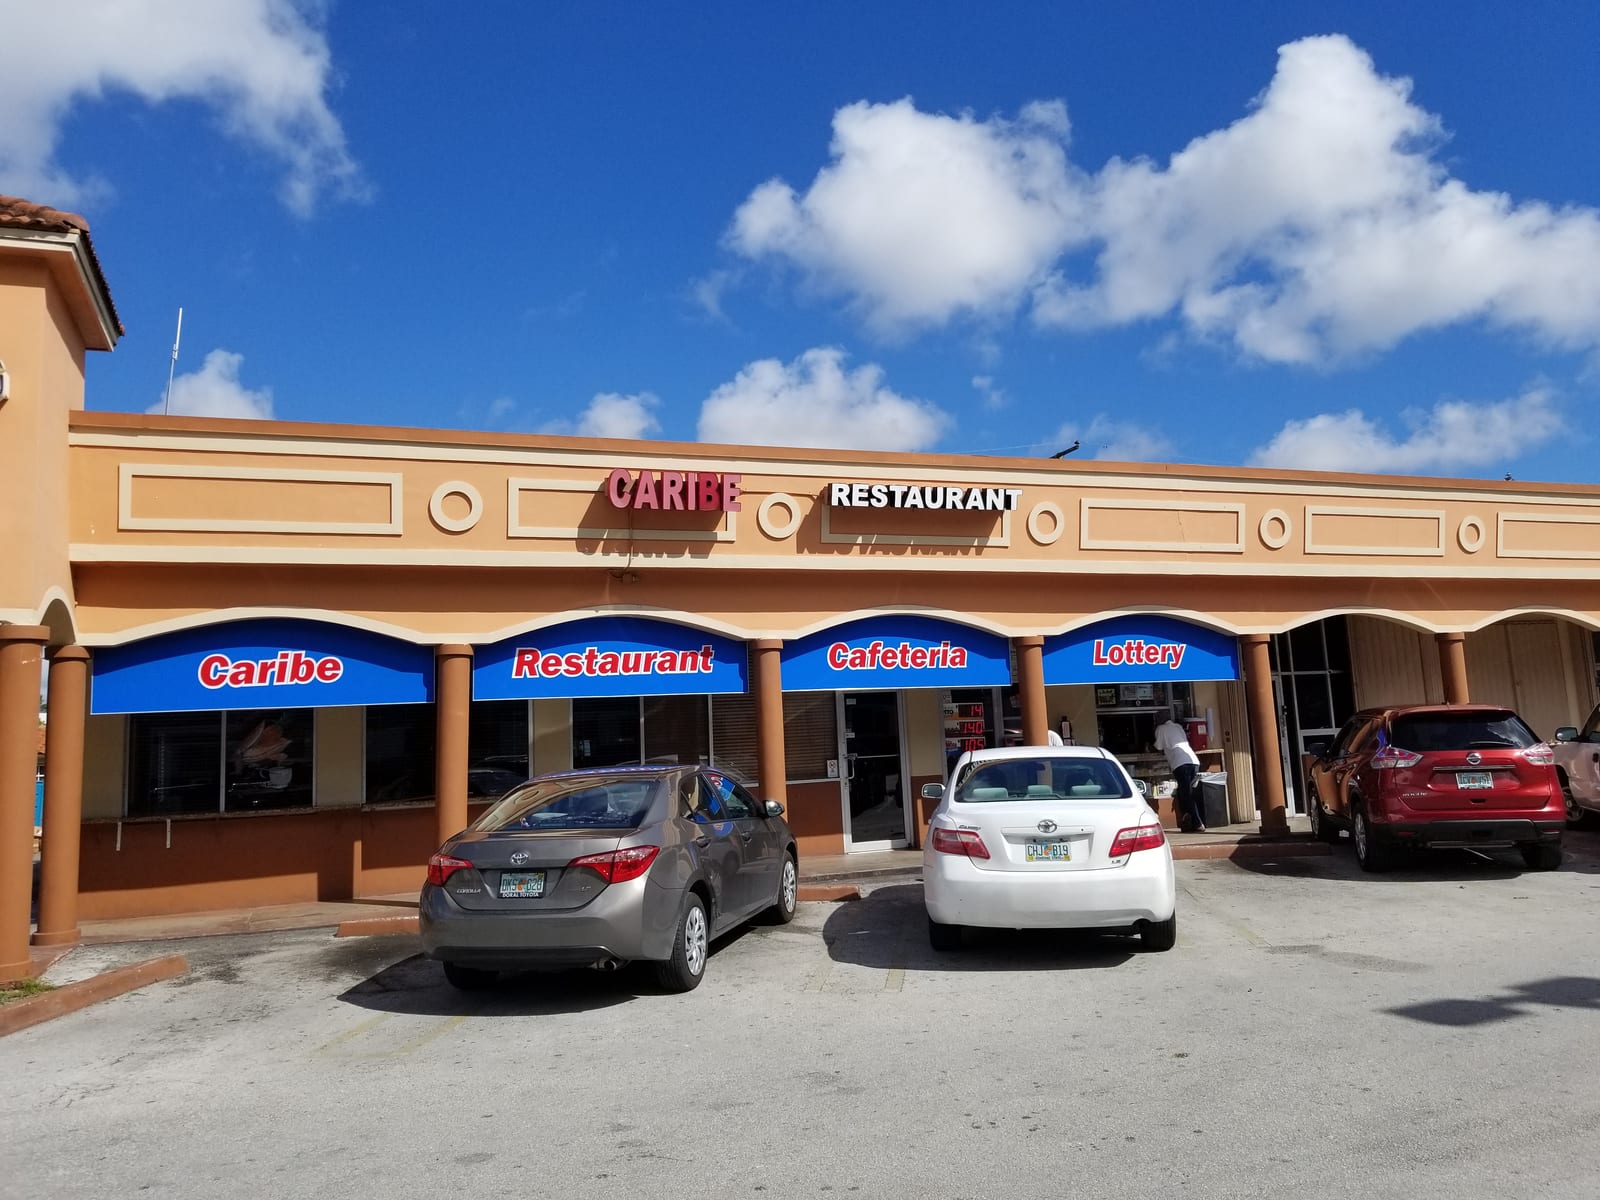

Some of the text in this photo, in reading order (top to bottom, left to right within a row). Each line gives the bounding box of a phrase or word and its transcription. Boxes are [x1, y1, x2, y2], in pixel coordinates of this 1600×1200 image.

[608, 468, 742, 513] CARIBE
[829, 483, 1023, 511] RESTAURANT
[511, 645, 715, 679] Restaurant
[827, 640, 968, 671] Cafeteria
[1093, 639, 1187, 670] Lottery
[198, 650, 344, 690] Caribe
[970, 704, 983, 717] 14
[963, 721, 984, 735] 140
[964, 737, 986, 752] 105
[1027, 844, 1069, 857] CHJ B19
